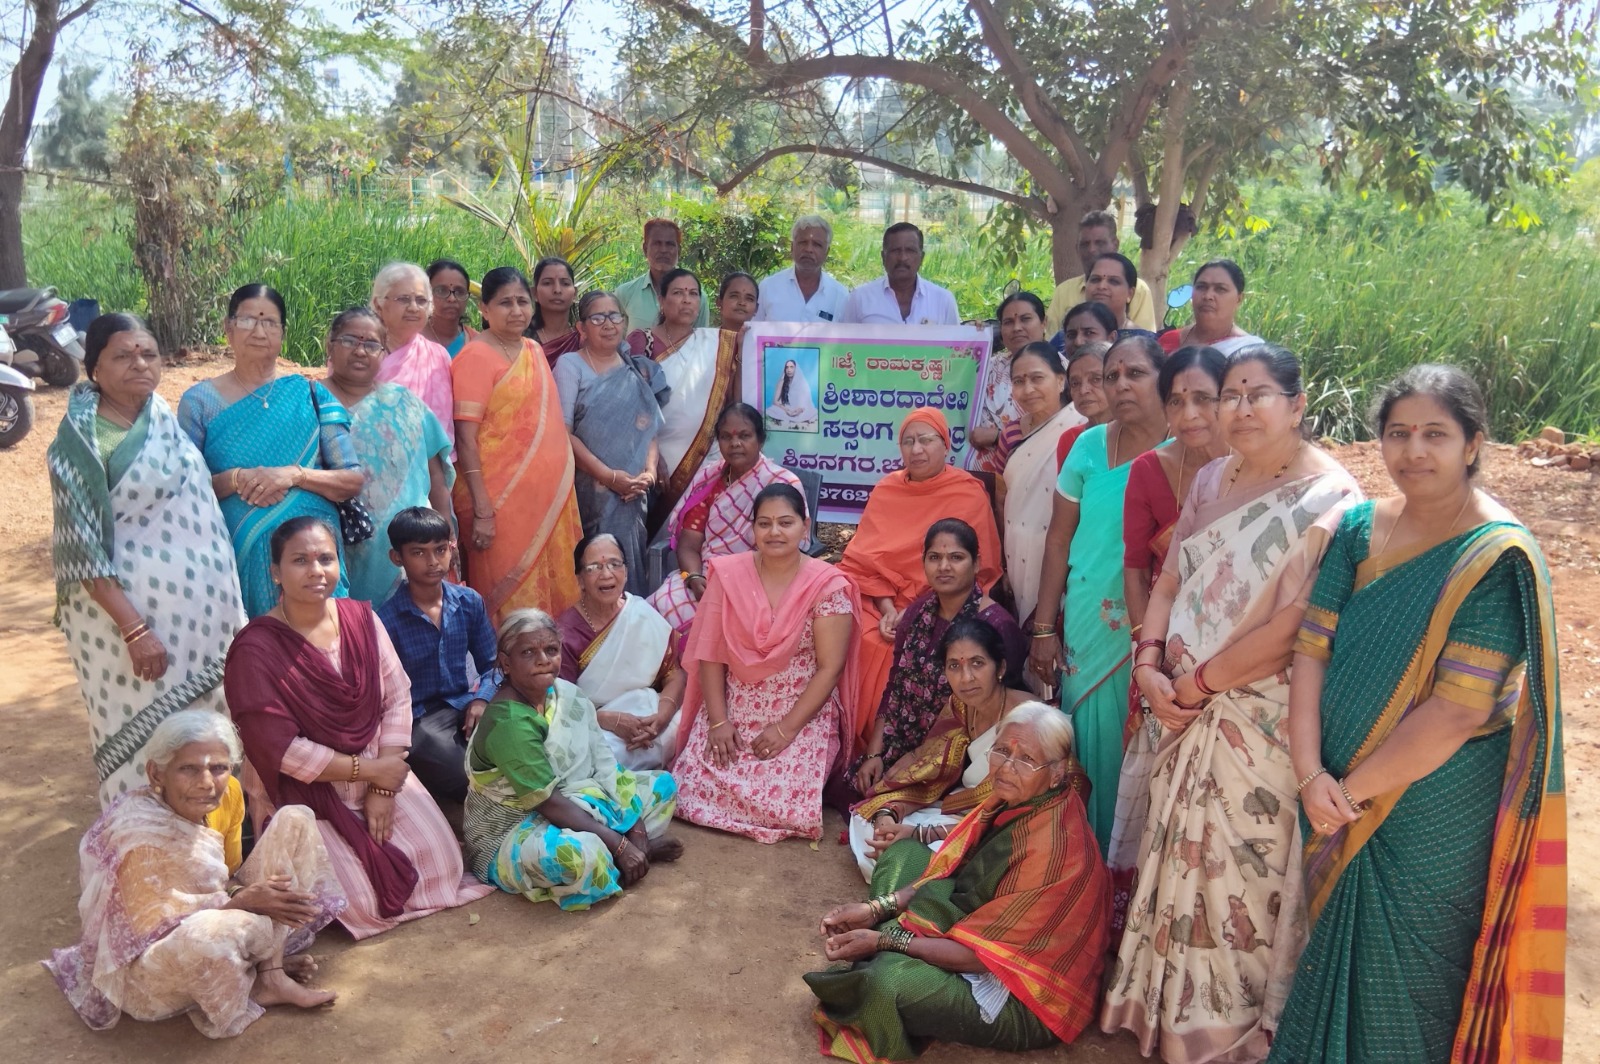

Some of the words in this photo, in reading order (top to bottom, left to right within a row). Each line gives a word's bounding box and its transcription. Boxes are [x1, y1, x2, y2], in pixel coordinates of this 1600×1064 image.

[821, 382, 969, 413] ಶ್ರೀಶಾರದಾದೇವಿ
[823, 419, 893, 450] ಸತ್ಸಂಗ
[819, 487, 870, 502] 8762
